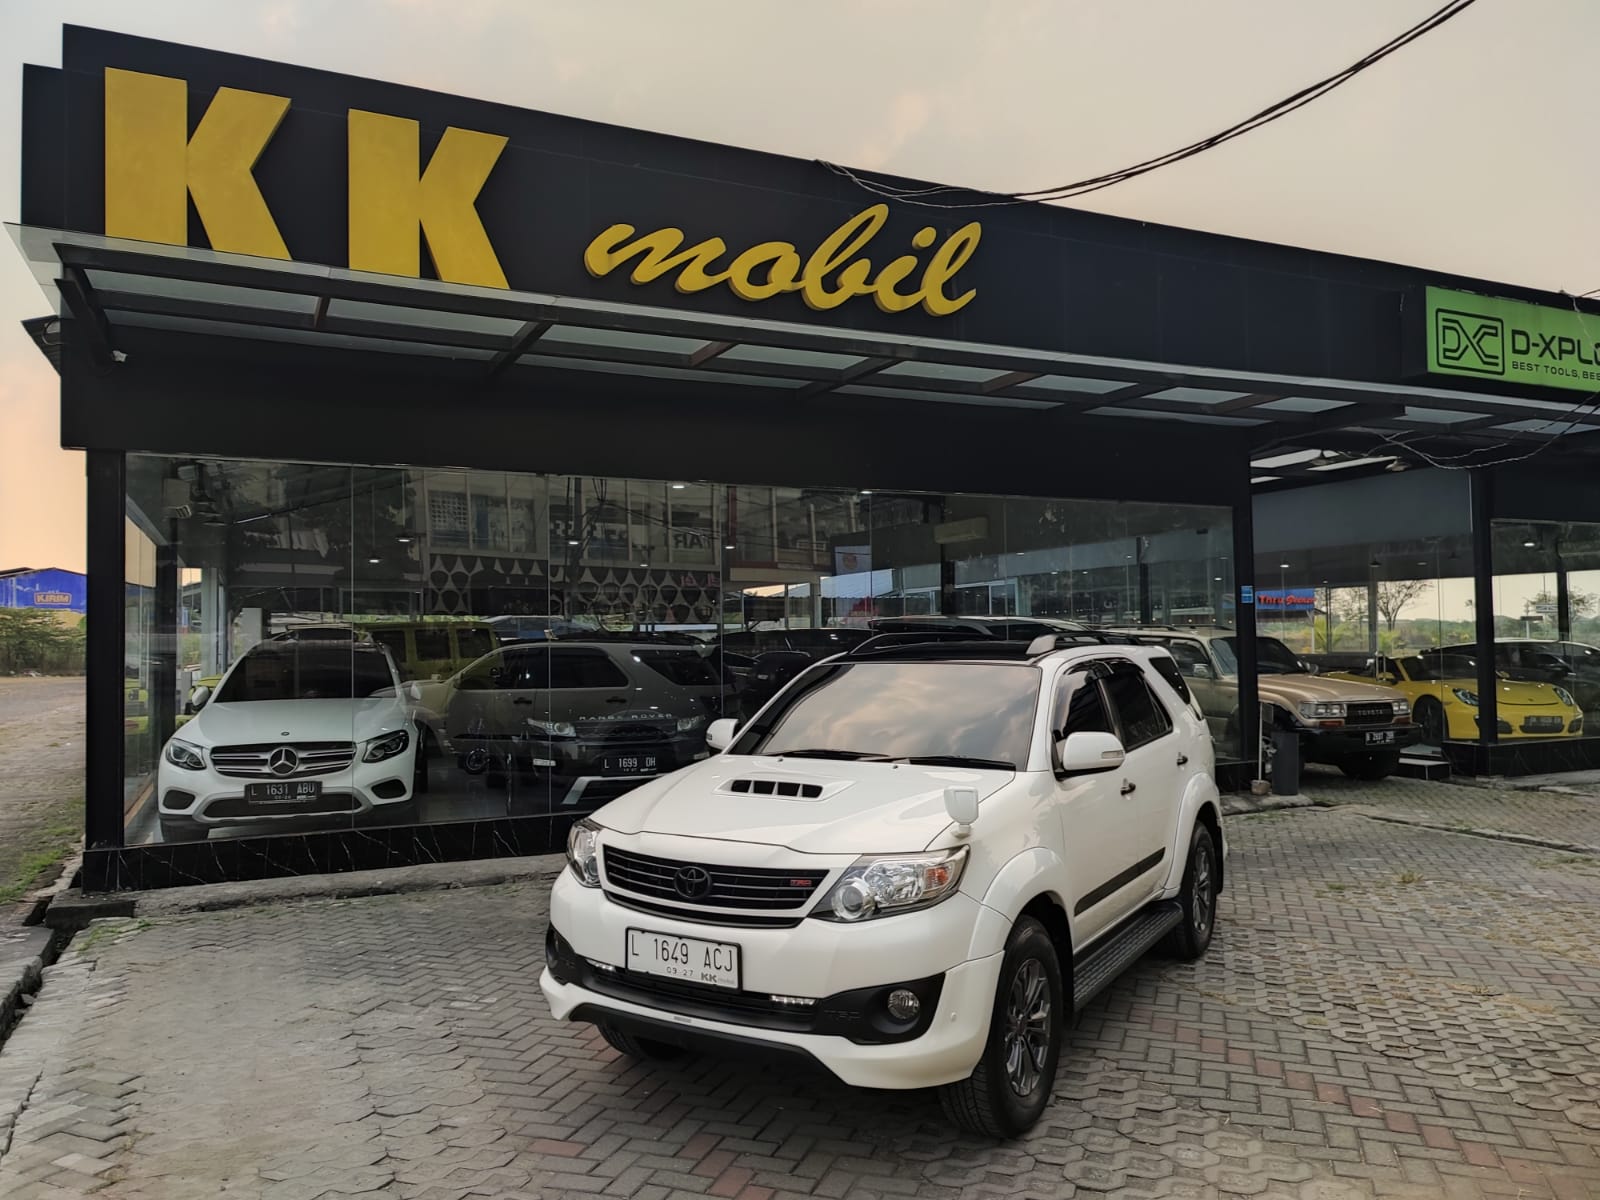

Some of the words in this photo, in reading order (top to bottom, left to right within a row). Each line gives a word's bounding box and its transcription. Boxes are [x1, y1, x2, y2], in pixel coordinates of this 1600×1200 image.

[584, 202, 982, 318] mobil
[1511, 361, 1540, 372] BEST
[1543, 365, 1580, 380] TOOLS,
[604, 759, 610, 769] L
[618, 757, 638, 768] 1699
[251, 785, 257, 796] L
[266, 784, 289, 795] 1631
[631, 934, 640, 956] L
[653, 938, 689, 965] 1649
[704, 946, 733, 972] ACJ
[701, 972, 717, 983] KK
